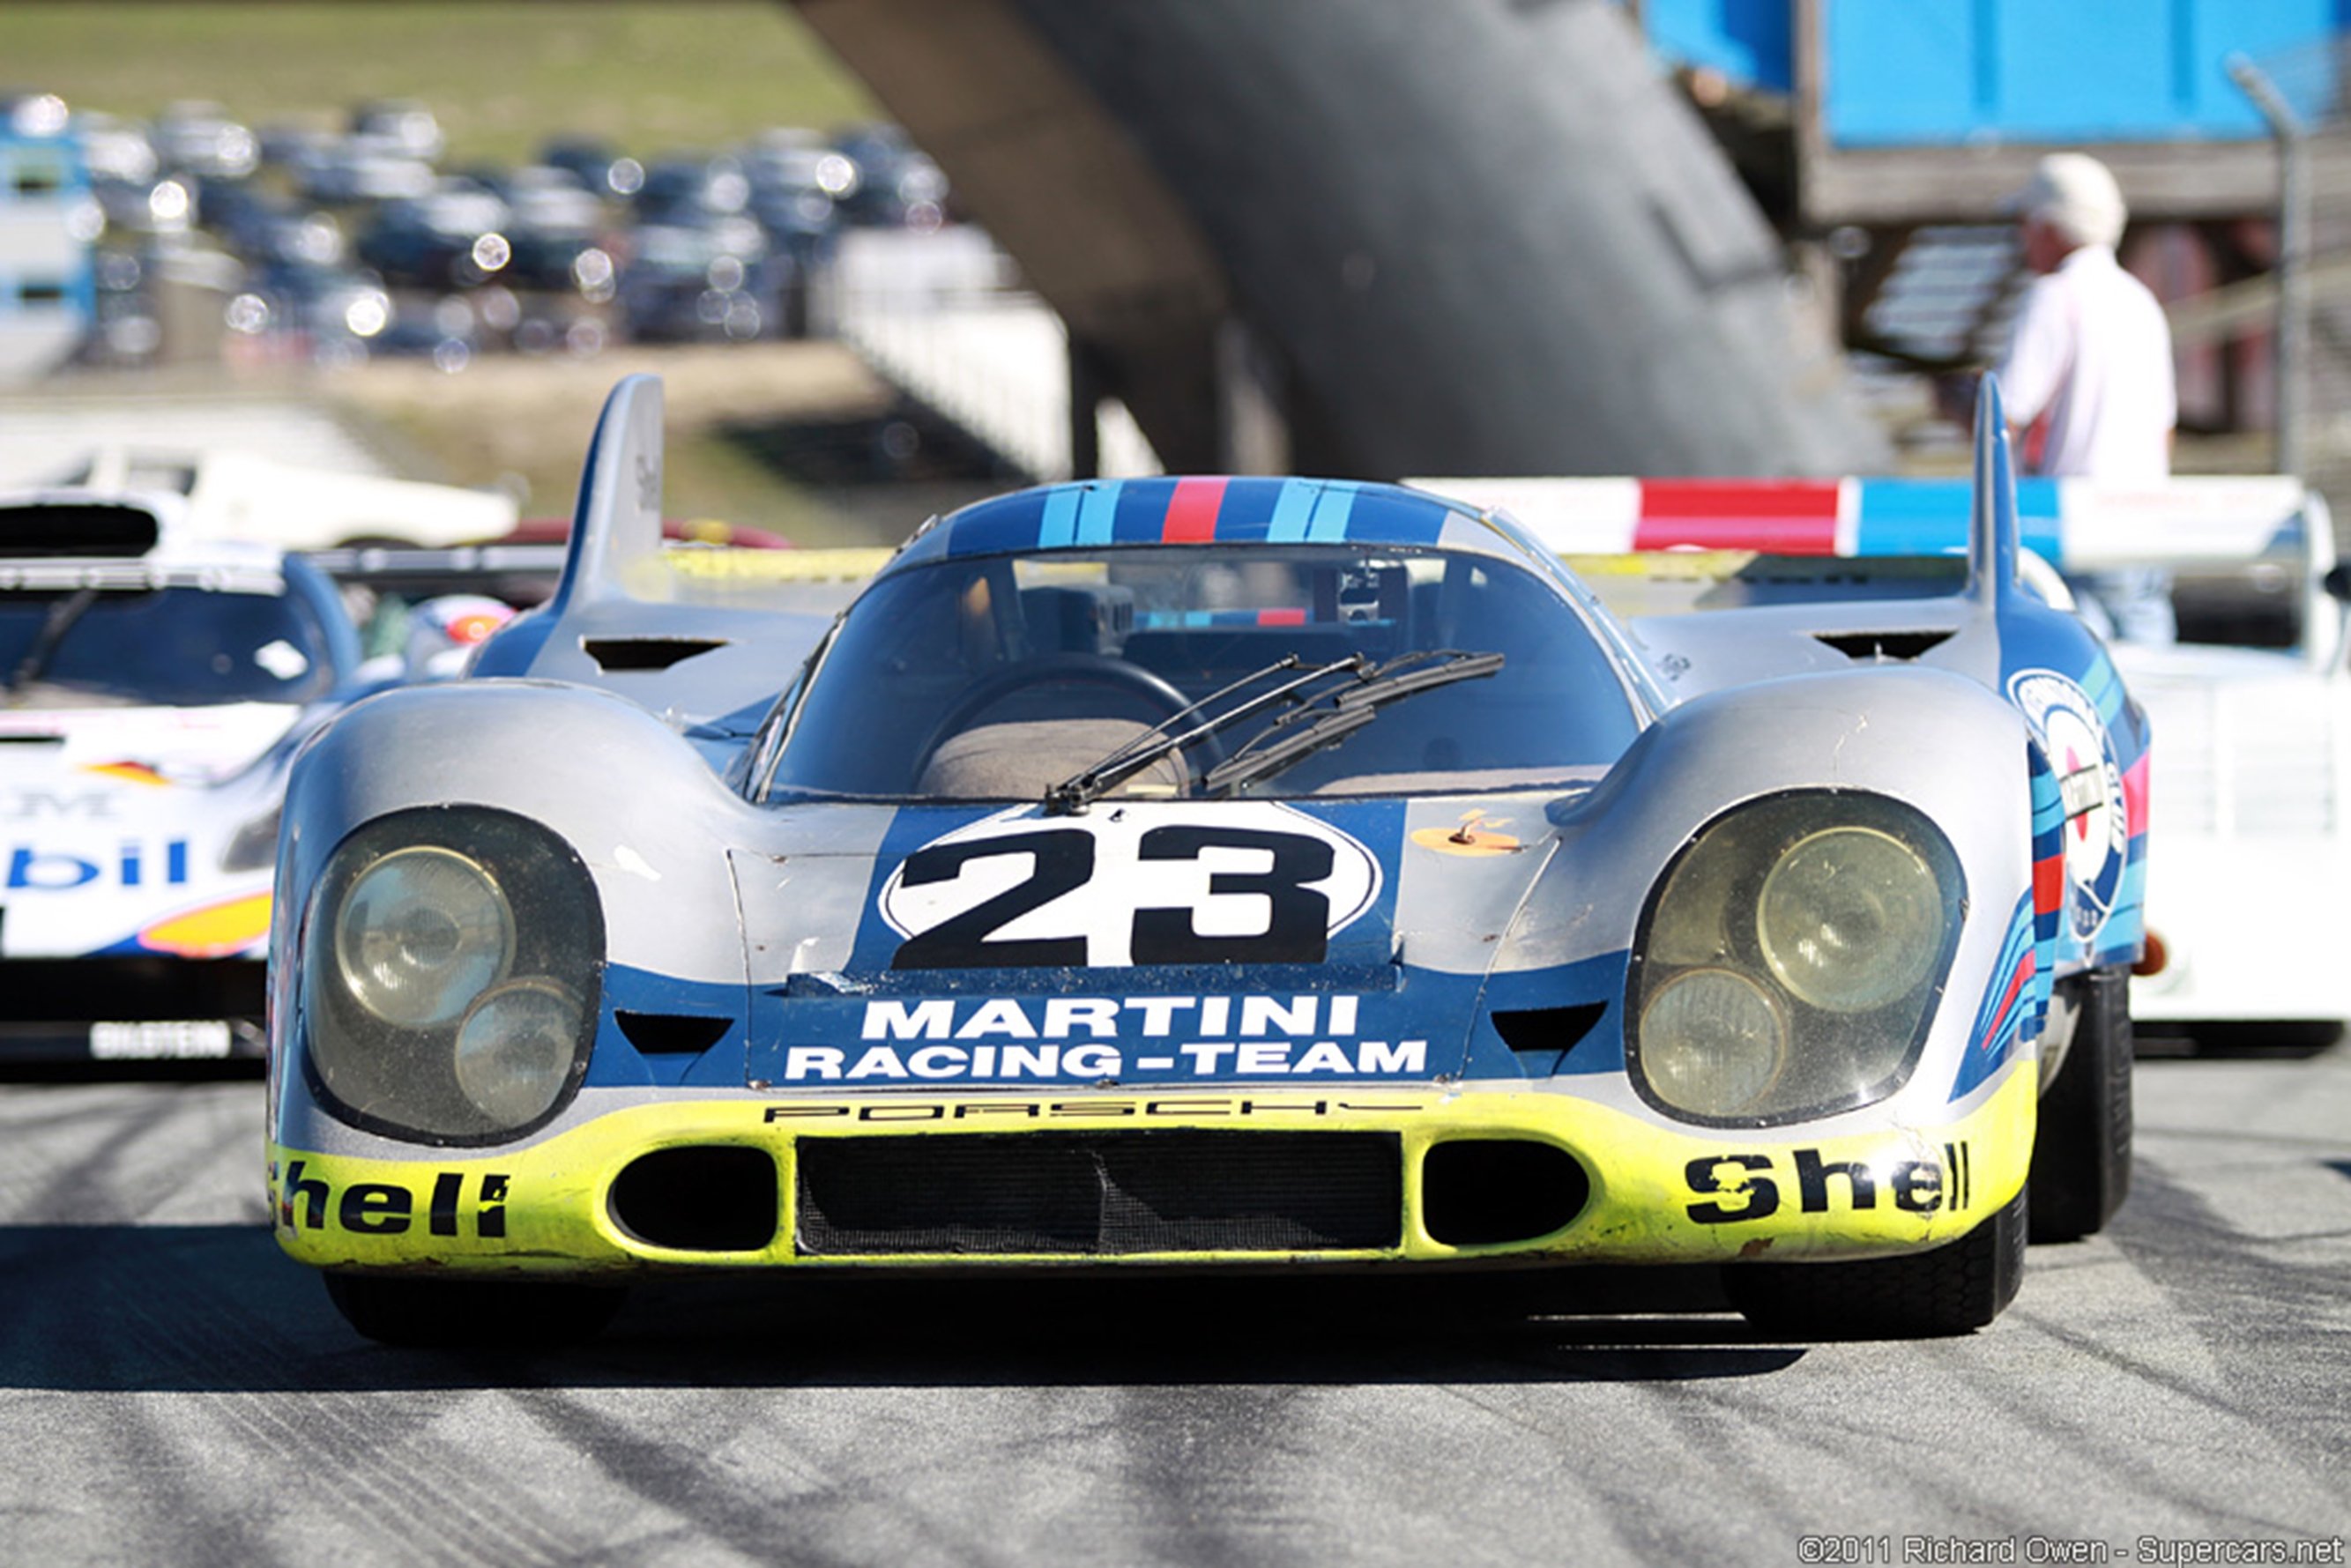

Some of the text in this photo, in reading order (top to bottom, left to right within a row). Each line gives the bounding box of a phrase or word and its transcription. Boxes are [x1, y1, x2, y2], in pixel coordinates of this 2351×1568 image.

[4, 839, 188, 889] bil
[889, 824, 1335, 970] 23
[860, 995, 1359, 1039] MARTINI
[268, 1160, 510, 1238] hell
[1685, 1141, 1969, 1225] Shell
